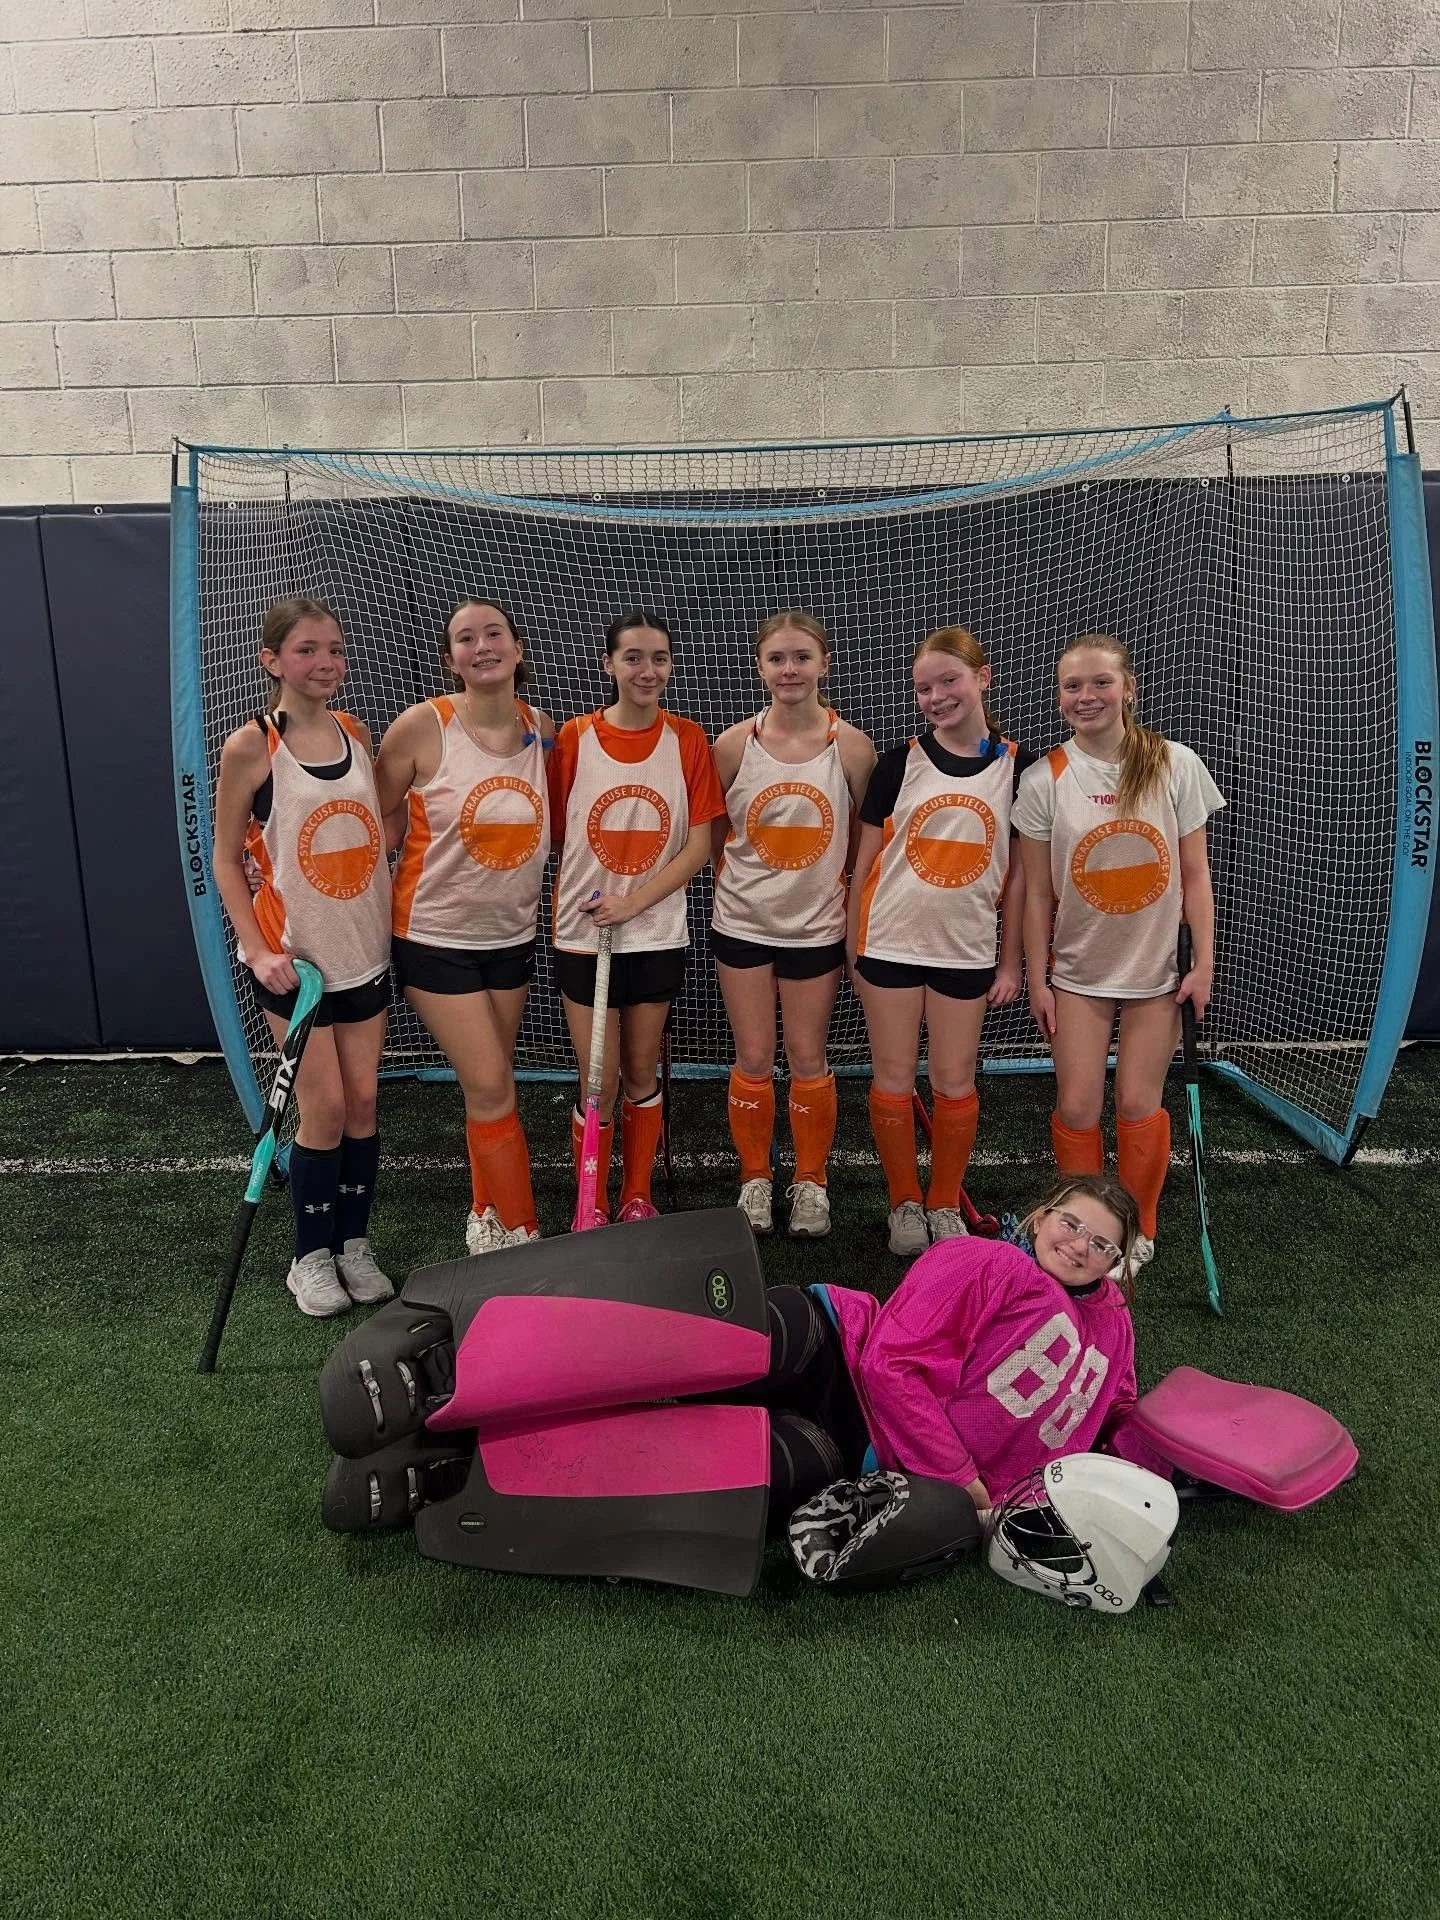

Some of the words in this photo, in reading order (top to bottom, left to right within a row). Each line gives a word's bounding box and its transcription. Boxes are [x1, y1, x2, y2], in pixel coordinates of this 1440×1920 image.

[503, 779, 531, 794] FIELD
[631, 786, 659, 803] FIELD
[790, 784, 819, 799] FIELD
[337, 802, 364, 816] FIELD
[463, 780, 499, 824] SYRACUSE
[589, 787, 627, 830] SYRACUSE
[748, 785, 786, 827] SYRACUSE
[957, 796, 987, 814] FIELD
[1411, 741, 1432, 867] BLOCKSTAR
[200, 814, 206, 827] ON
[658, 802, 670, 847] HOCKEY
[818, 799, 833, 844] HOCKEY
[910, 796, 952, 838] SYRACUSE
[1404, 810, 1411, 822] ON
[182, 773, 206, 896] BLOCKSTAR
[300, 804, 334, 856] SYRACUSE
[364, 815, 380, 859] HOCKEY
[984, 815, 994, 862] HOCKEY
[1117, 822, 1150, 834] FIELD
[516, 842, 537, 865] CLUB
[593, 843, 612, 866] 2016
[801, 846, 824, 867] CLUB
[1074, 824, 1112, 873] SYRACUSE
[1152, 832, 1169, 878] HOCKEY
[613, 864, 629, 873] EST
[641, 850, 660, 871] CLUB
[908, 850, 926, 874] 2016
[306, 869, 331, 893] 2016
[925, 873, 946, 885] EST
[961, 864, 985, 884] CLUB
[334, 888, 350, 898] EST
[1141, 882, 1166, 905] CLUB
[1105, 903, 1126, 913] EST
[269, 1051, 298, 1114] STX
[729, 1096, 760, 1109] STX
[712, 1275, 727, 1309] OBO
[987, 1312, 1109, 1449] 88
[1051, 1461, 1063, 1483] OBO
[1094, 1584, 1123, 1606] OBO
